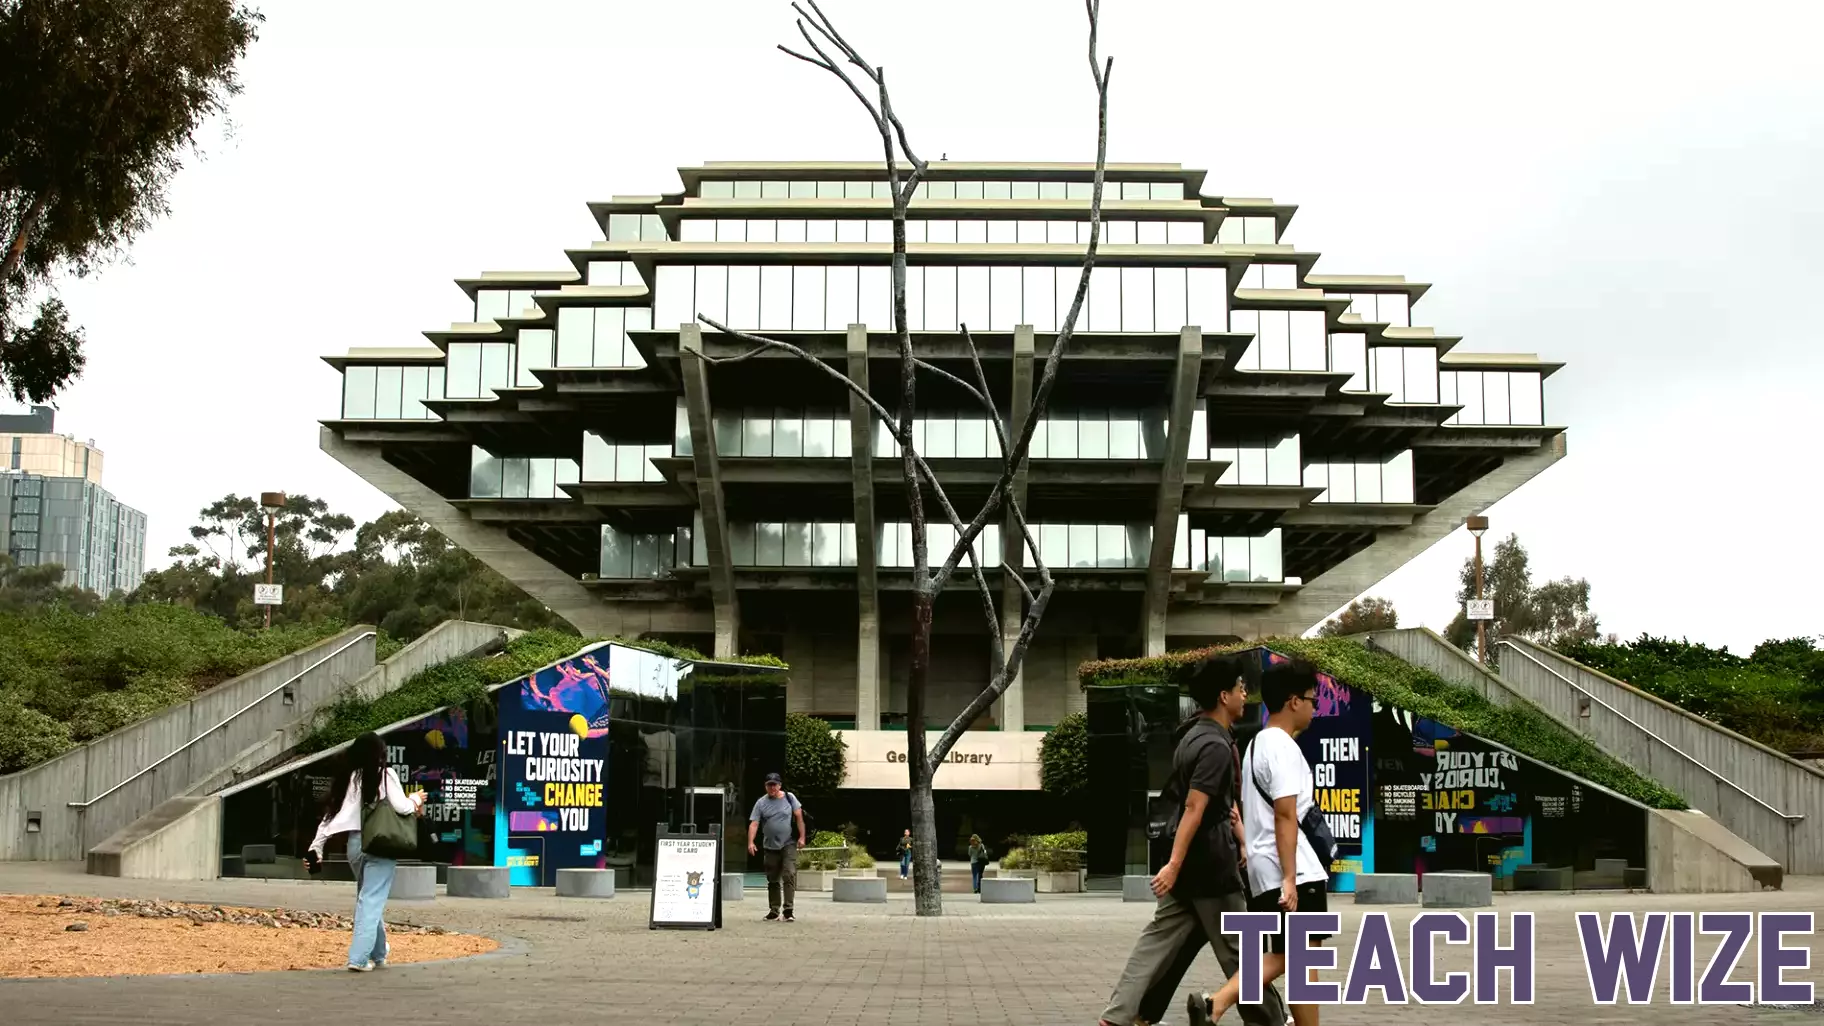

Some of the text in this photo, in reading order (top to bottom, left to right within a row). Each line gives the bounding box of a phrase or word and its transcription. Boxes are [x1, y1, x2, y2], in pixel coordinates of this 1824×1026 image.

[508, 731, 579, 757] LET YOUR
[1320, 737, 1359, 762] THEN
[526, 757, 604, 783] CURIOSITY
[1315, 763, 1335, 787] GO
[544, 783, 603, 806] CHANGE
[560, 807, 589, 832] YOU
